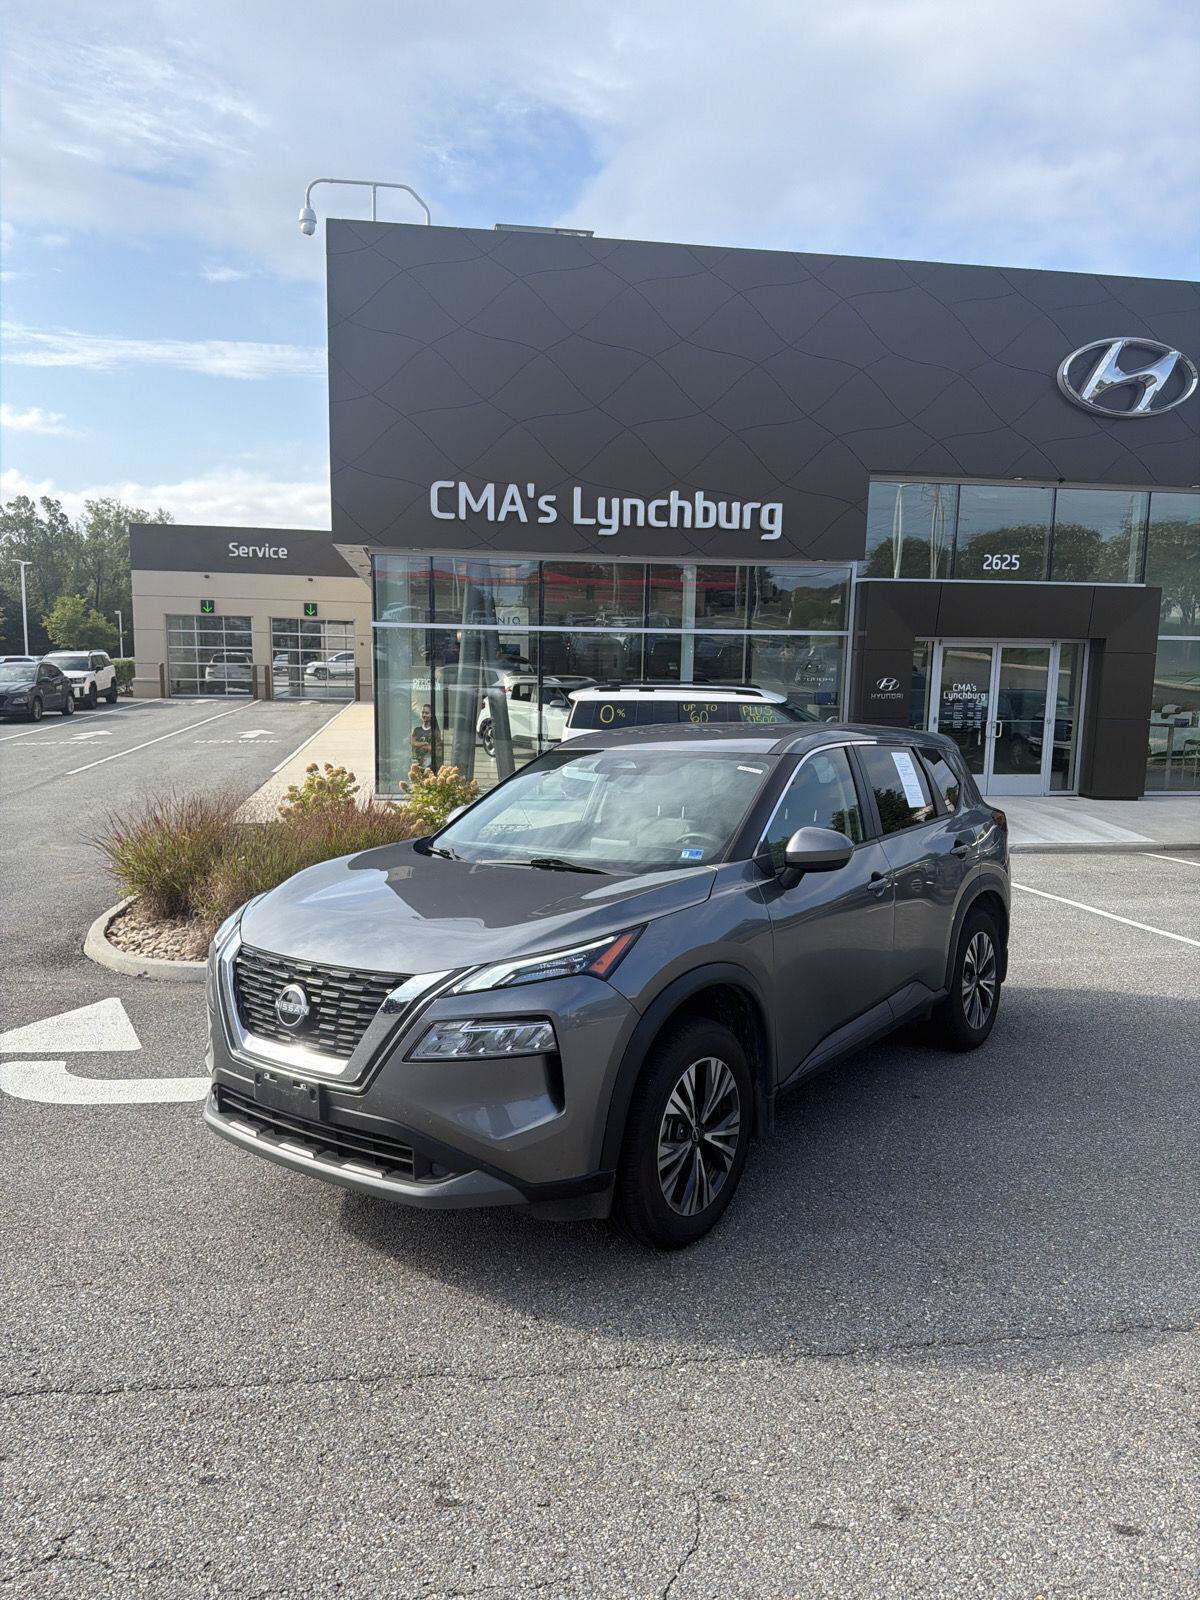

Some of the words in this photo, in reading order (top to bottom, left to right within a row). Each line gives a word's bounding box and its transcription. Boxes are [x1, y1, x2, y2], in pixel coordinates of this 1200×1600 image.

[430, 480, 558, 524] CMA's
[573, 486, 783, 541] Lynchburg
[228, 542, 288, 559] Service
[983, 554, 1020, 570] 2625
[953, 683, 977, 692] CMA's
[943, 692, 986, 701] Lynchburg
[683, 703, 696, 711] UP
[705, 703, 718, 711] TO
[742, 705, 773, 716] PLUS
[690, 710, 709, 723] 60
[274, 998, 311, 1016] NISSAN
